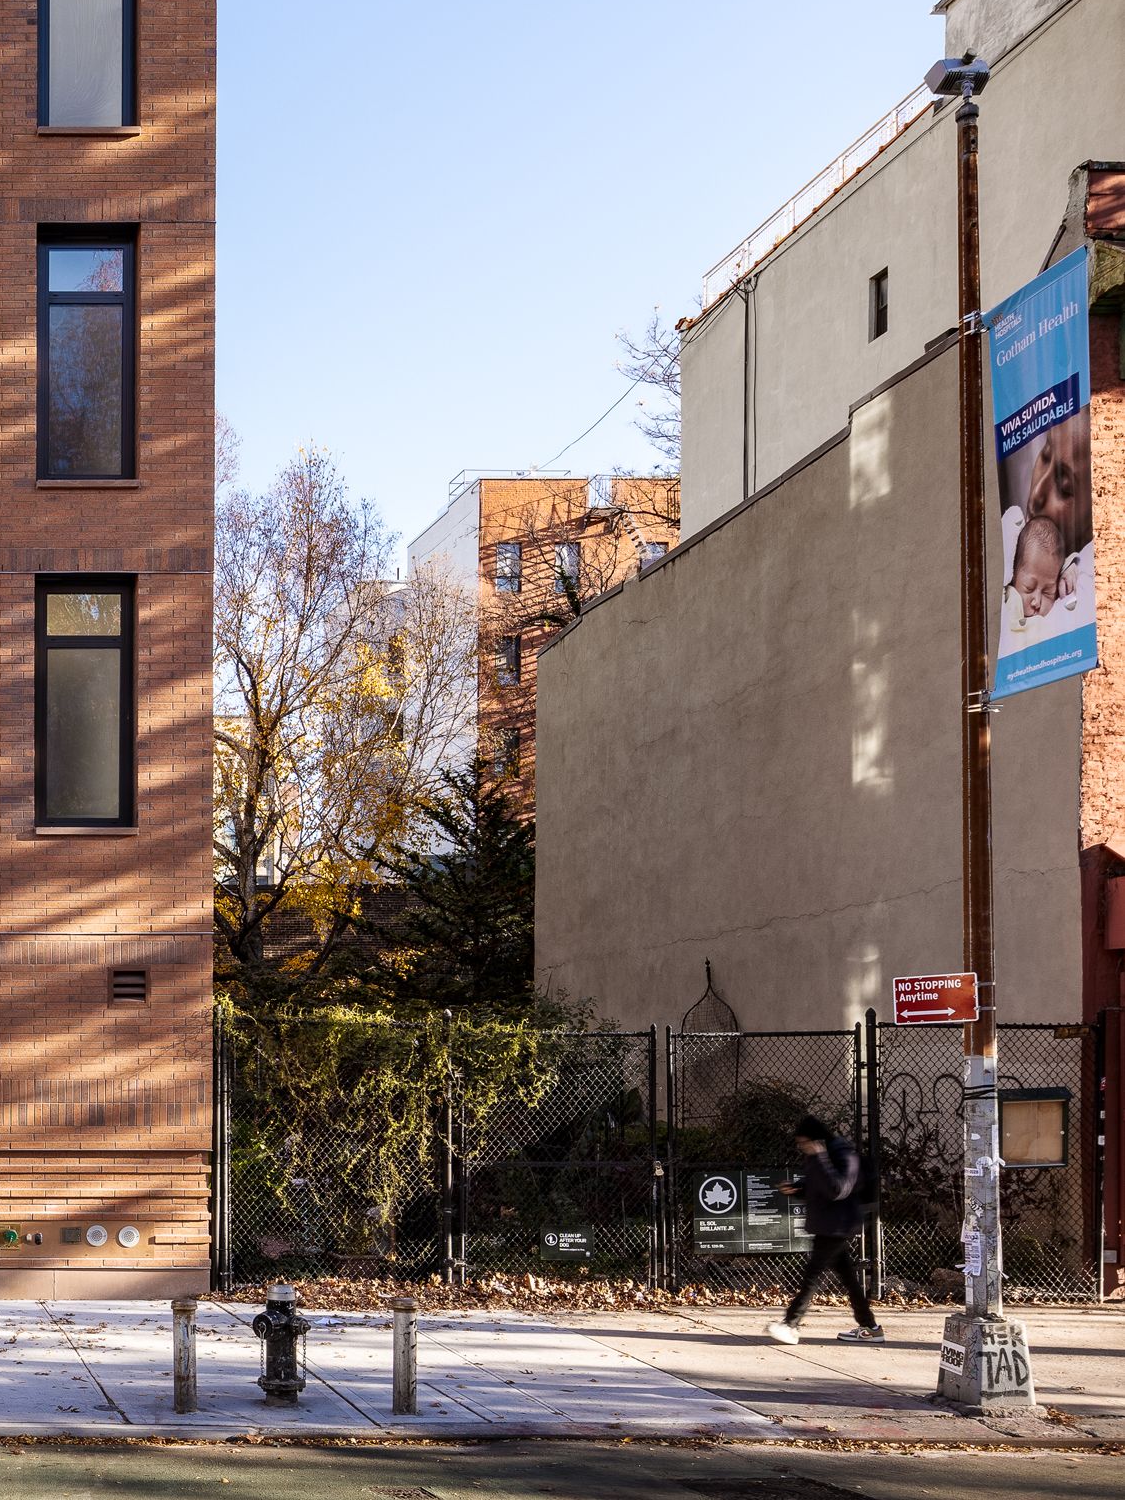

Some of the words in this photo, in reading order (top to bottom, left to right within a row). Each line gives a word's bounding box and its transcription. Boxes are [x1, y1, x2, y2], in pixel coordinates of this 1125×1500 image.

[995, 312, 1015, 331] HEALTH
[995, 314, 1022, 340] HOSPITALS
[996, 331, 1036, 367] Gotham
[1038, 301, 1079, 338] Health
[1001, 416, 1022, 437] VIVA
[1021, 406, 1033, 423] SU
[1032, 392, 1057, 415] VIDA
[1002, 431, 1022, 453] MÁS
[1022, 398, 1074, 441] SALUDABLE
[898, 982, 912, 992] NO
[914, 979, 962, 991] STOPPING
[899, 992, 939, 1003] Anytime
[977, 1347, 1029, 1390] TAD
